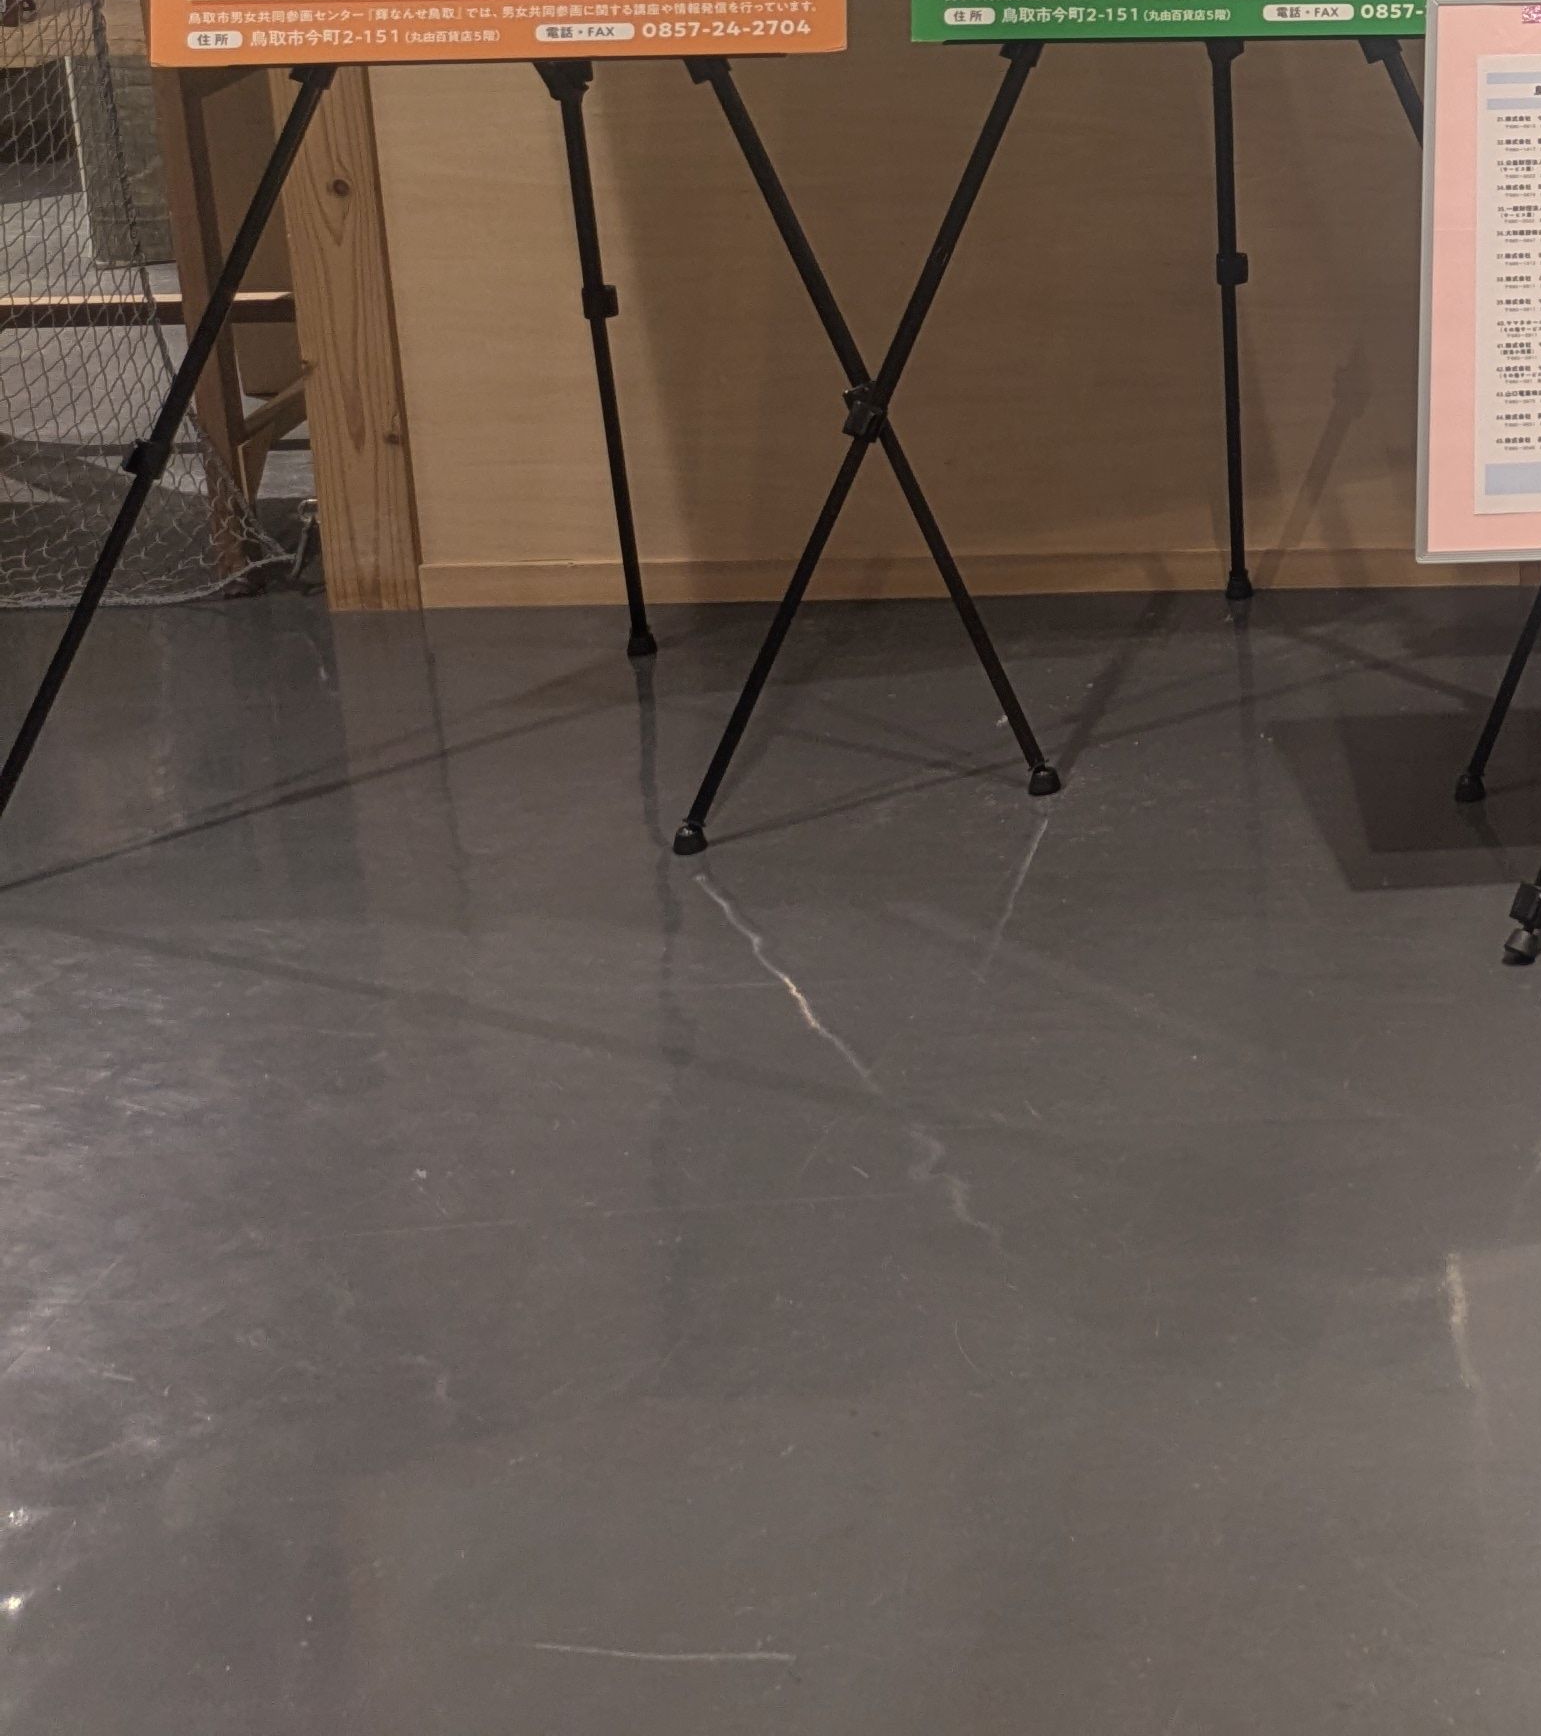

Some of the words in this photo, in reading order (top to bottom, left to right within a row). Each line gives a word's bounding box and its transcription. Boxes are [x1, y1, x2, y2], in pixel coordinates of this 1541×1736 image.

[953, 10, 983, 22] 住所
[196, 32, 229, 47] 住所
[642, 19, 811, 38] 0857-24-2704
